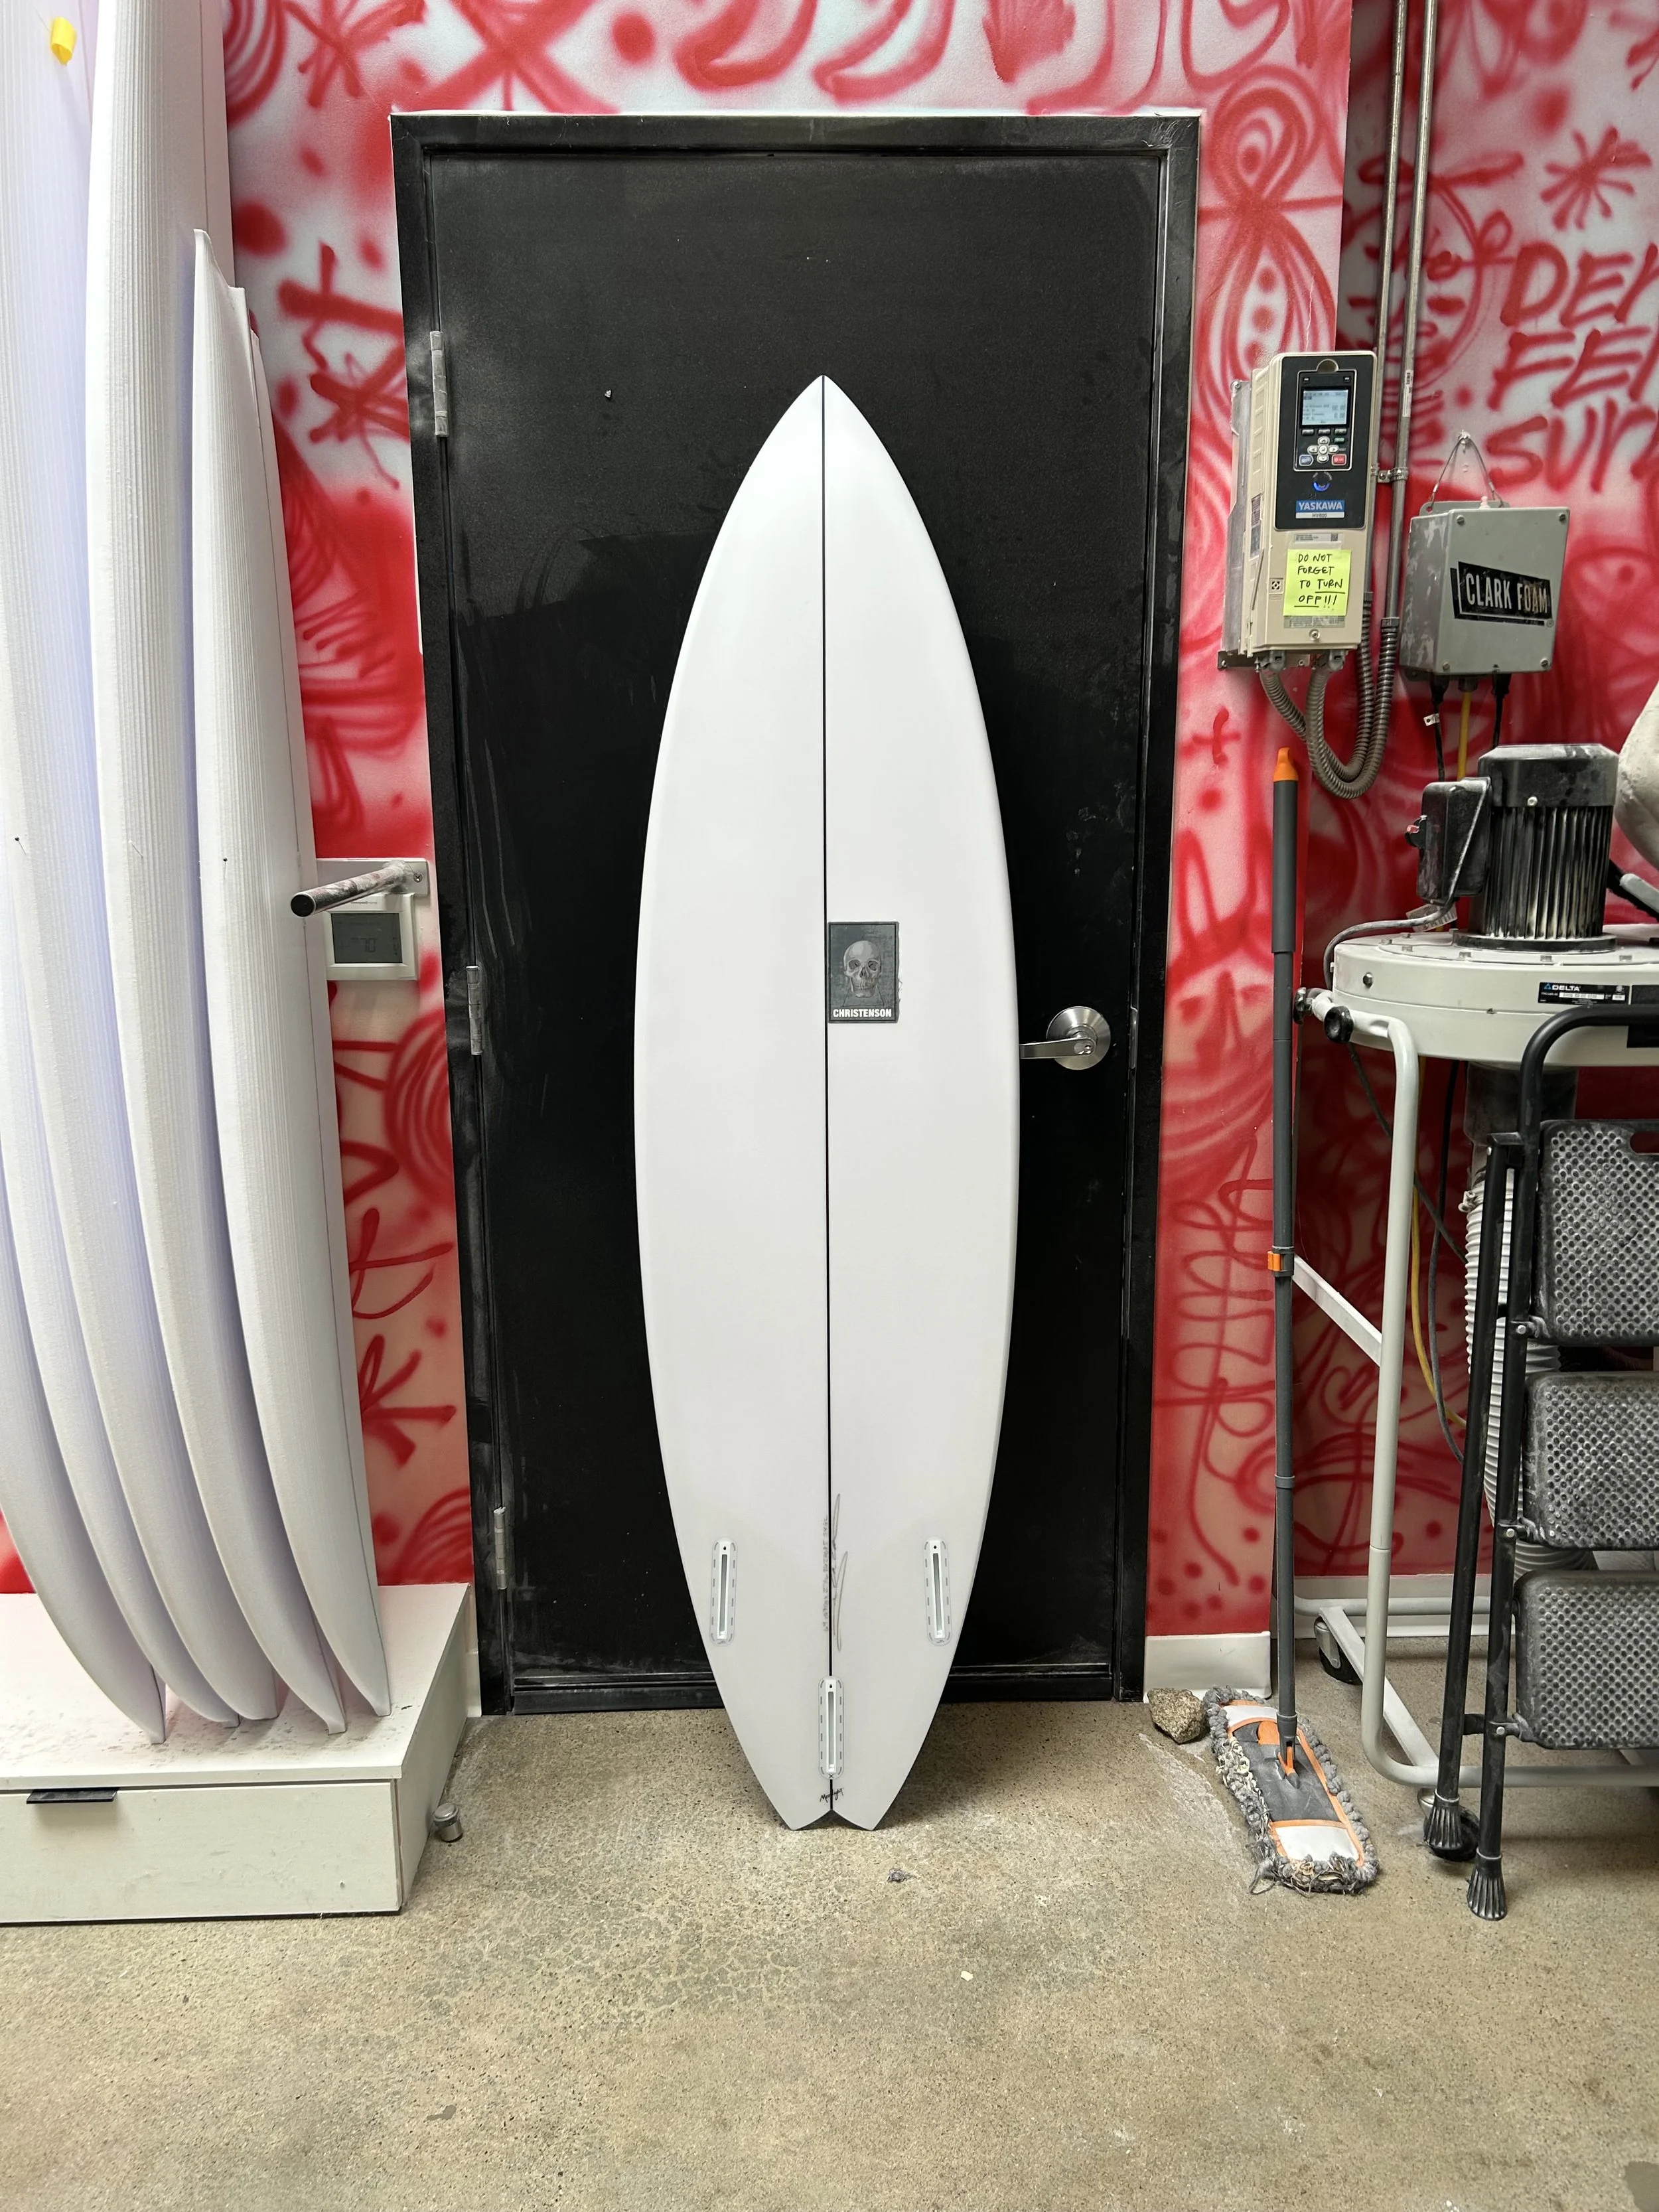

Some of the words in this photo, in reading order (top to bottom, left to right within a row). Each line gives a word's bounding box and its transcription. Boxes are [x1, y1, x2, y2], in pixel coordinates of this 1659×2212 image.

[1299, 501, 1342, 510] YASKAWA
[1298, 553, 1309, 563] DO
[1313, 553, 1333, 563] NOT
[1297, 565, 1334, 575] FORGET
[1299, 579, 1311, 589] TO
[1317, 578, 1343, 590] TURN
[1465, 573, 1512, 610] CLARK
[1516, 582, 1548, 615] FOAM
[833, 1008, 892, 1018] CHRISTENSON
